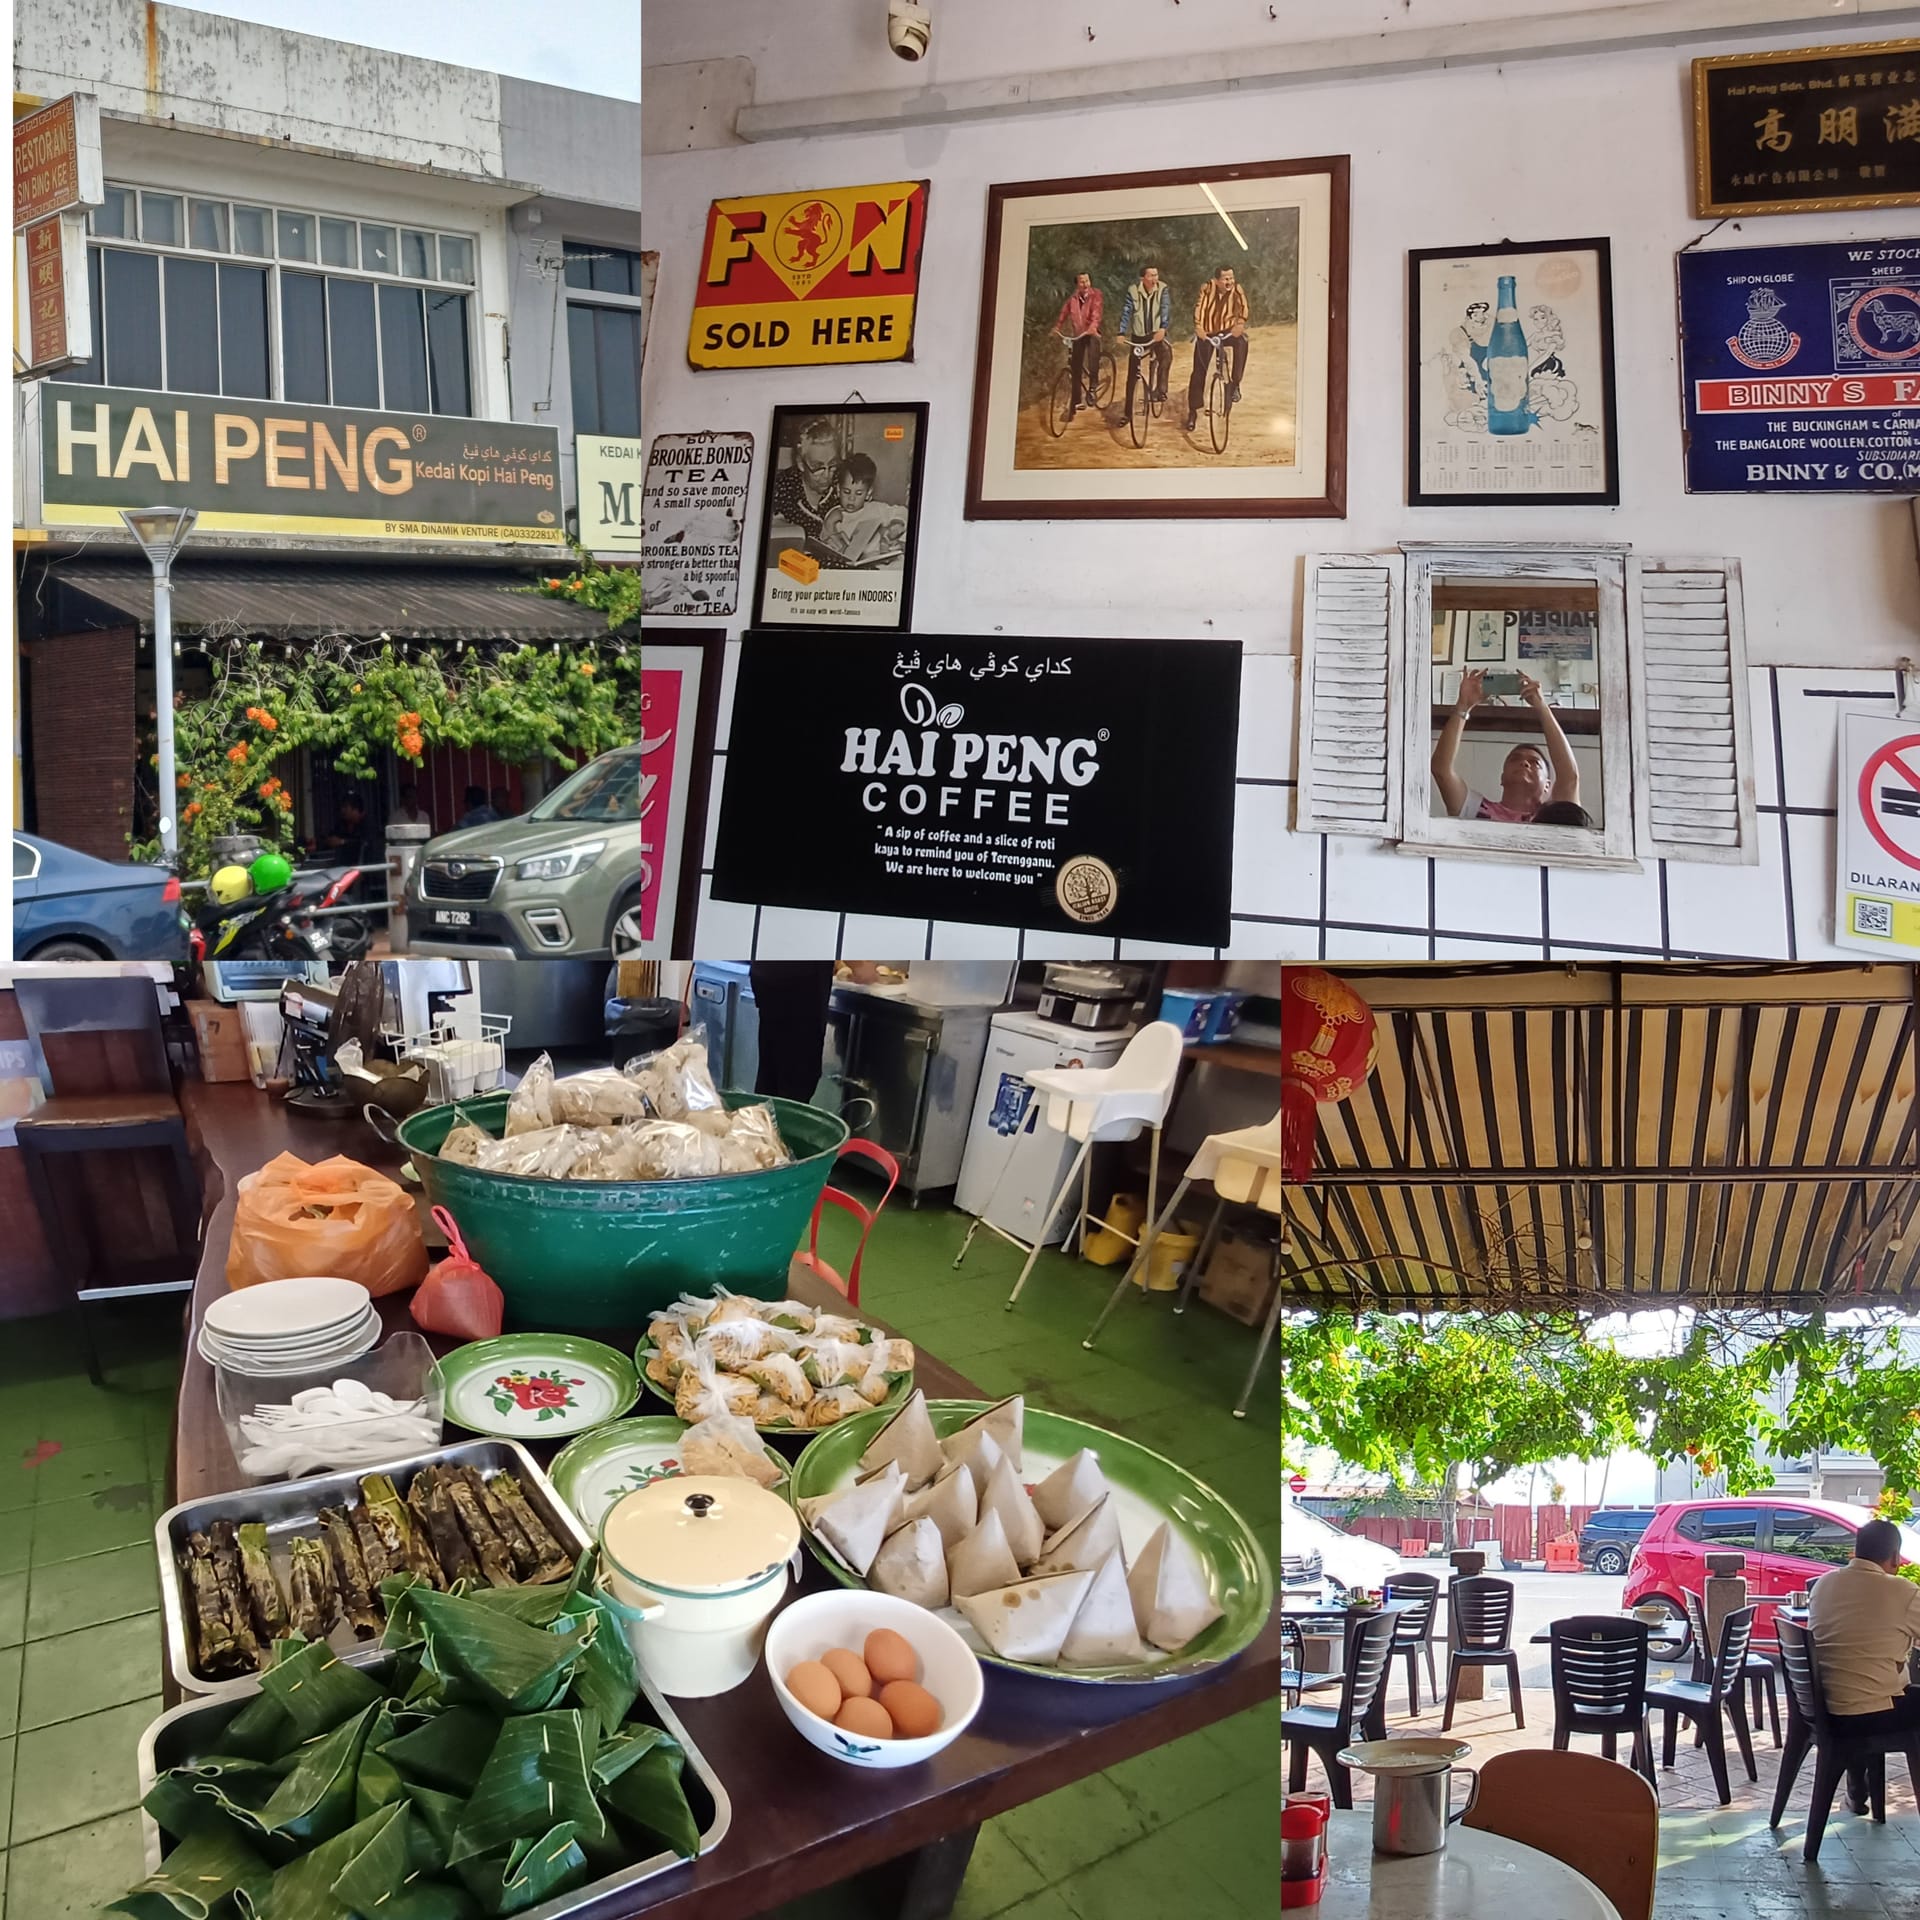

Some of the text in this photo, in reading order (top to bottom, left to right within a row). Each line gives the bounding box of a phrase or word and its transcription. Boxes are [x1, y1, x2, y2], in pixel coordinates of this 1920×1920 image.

[1727, 86, 1746, 96] Hai
[1748, 84, 1777, 95] Peng
[14, 123, 68, 177] RESTORAN
[17, 180, 31, 205] SIN
[32, 170, 50, 199] BING
[51, 162, 68, 190] KEE
[1847, 250, 1874, 262] WE
[1871, 266, 1903, 276] SHEEP
[1726, 273, 1795, 286] SHIP ON GLOBE
[703, 314, 894, 350] SOLD HERE
[1892, 410, 1902, 418] of
[1766, 421, 1787, 432] THE
[1792, 419, 1868, 432] BUCKINGHAM
[1872, 421, 1880, 429] &
[56, 399, 414, 497] HAI PENG
[600, 445, 634, 459] KEDAI
[1715, 440, 1737, 451] THE
[1739, 438, 1806, 450] BANGALORE
[415, 461, 554, 491] Kedai Kopi Hai Peng
[665, 468, 729, 483] TEA
[1746, 464, 1829, 482] BINNY
[644, 485, 665, 498] and
[667, 487, 680, 497] so
[682, 486, 708, 497] save
[653, 496, 736, 511] A small spoonful
[385, 522, 397, 533] BY
[399, 523, 419, 534] SMA
[421, 524, 459, 536] DINAMIK
[461, 526, 499, 538] VENTURE
[650, 520, 661, 532] of
[718, 545, 739, 557] TEA
[647, 558, 685, 570] stronger
[691, 558, 718, 570] better
[683, 569, 739, 585] a big spoonful
[716, 586, 727, 598] of
[771, 587, 898, 603] Bring your picture fun INDOORS!
[703, 601, 732, 614] TEA
[926, 653, 963, 680] هاي
[1024, 655, 1072, 683] كداي
[840, 726, 1100, 787] HAI PENG
[862, 781, 1070, 826] COFFEE
[895, 826, 912, 840] sip
[913, 828, 926, 841] of
[927, 829, 961, 843] coffee
[963, 832, 984, 845] and
[985, 835, 993, 845] a
[994, 833, 1018, 848] slice
[1020, 836, 1033, 850] of
[1035, 837, 1056, 851] roti
[874, 842, 1056, 870] kaya to remind you of Terengganu.
[885, 860, 904, 875] We
[906, 864, 923, 876] are
[925, 863, 950, 877] here
[952, 866, 963, 878] to
[965, 867, 1012, 884] welcome
